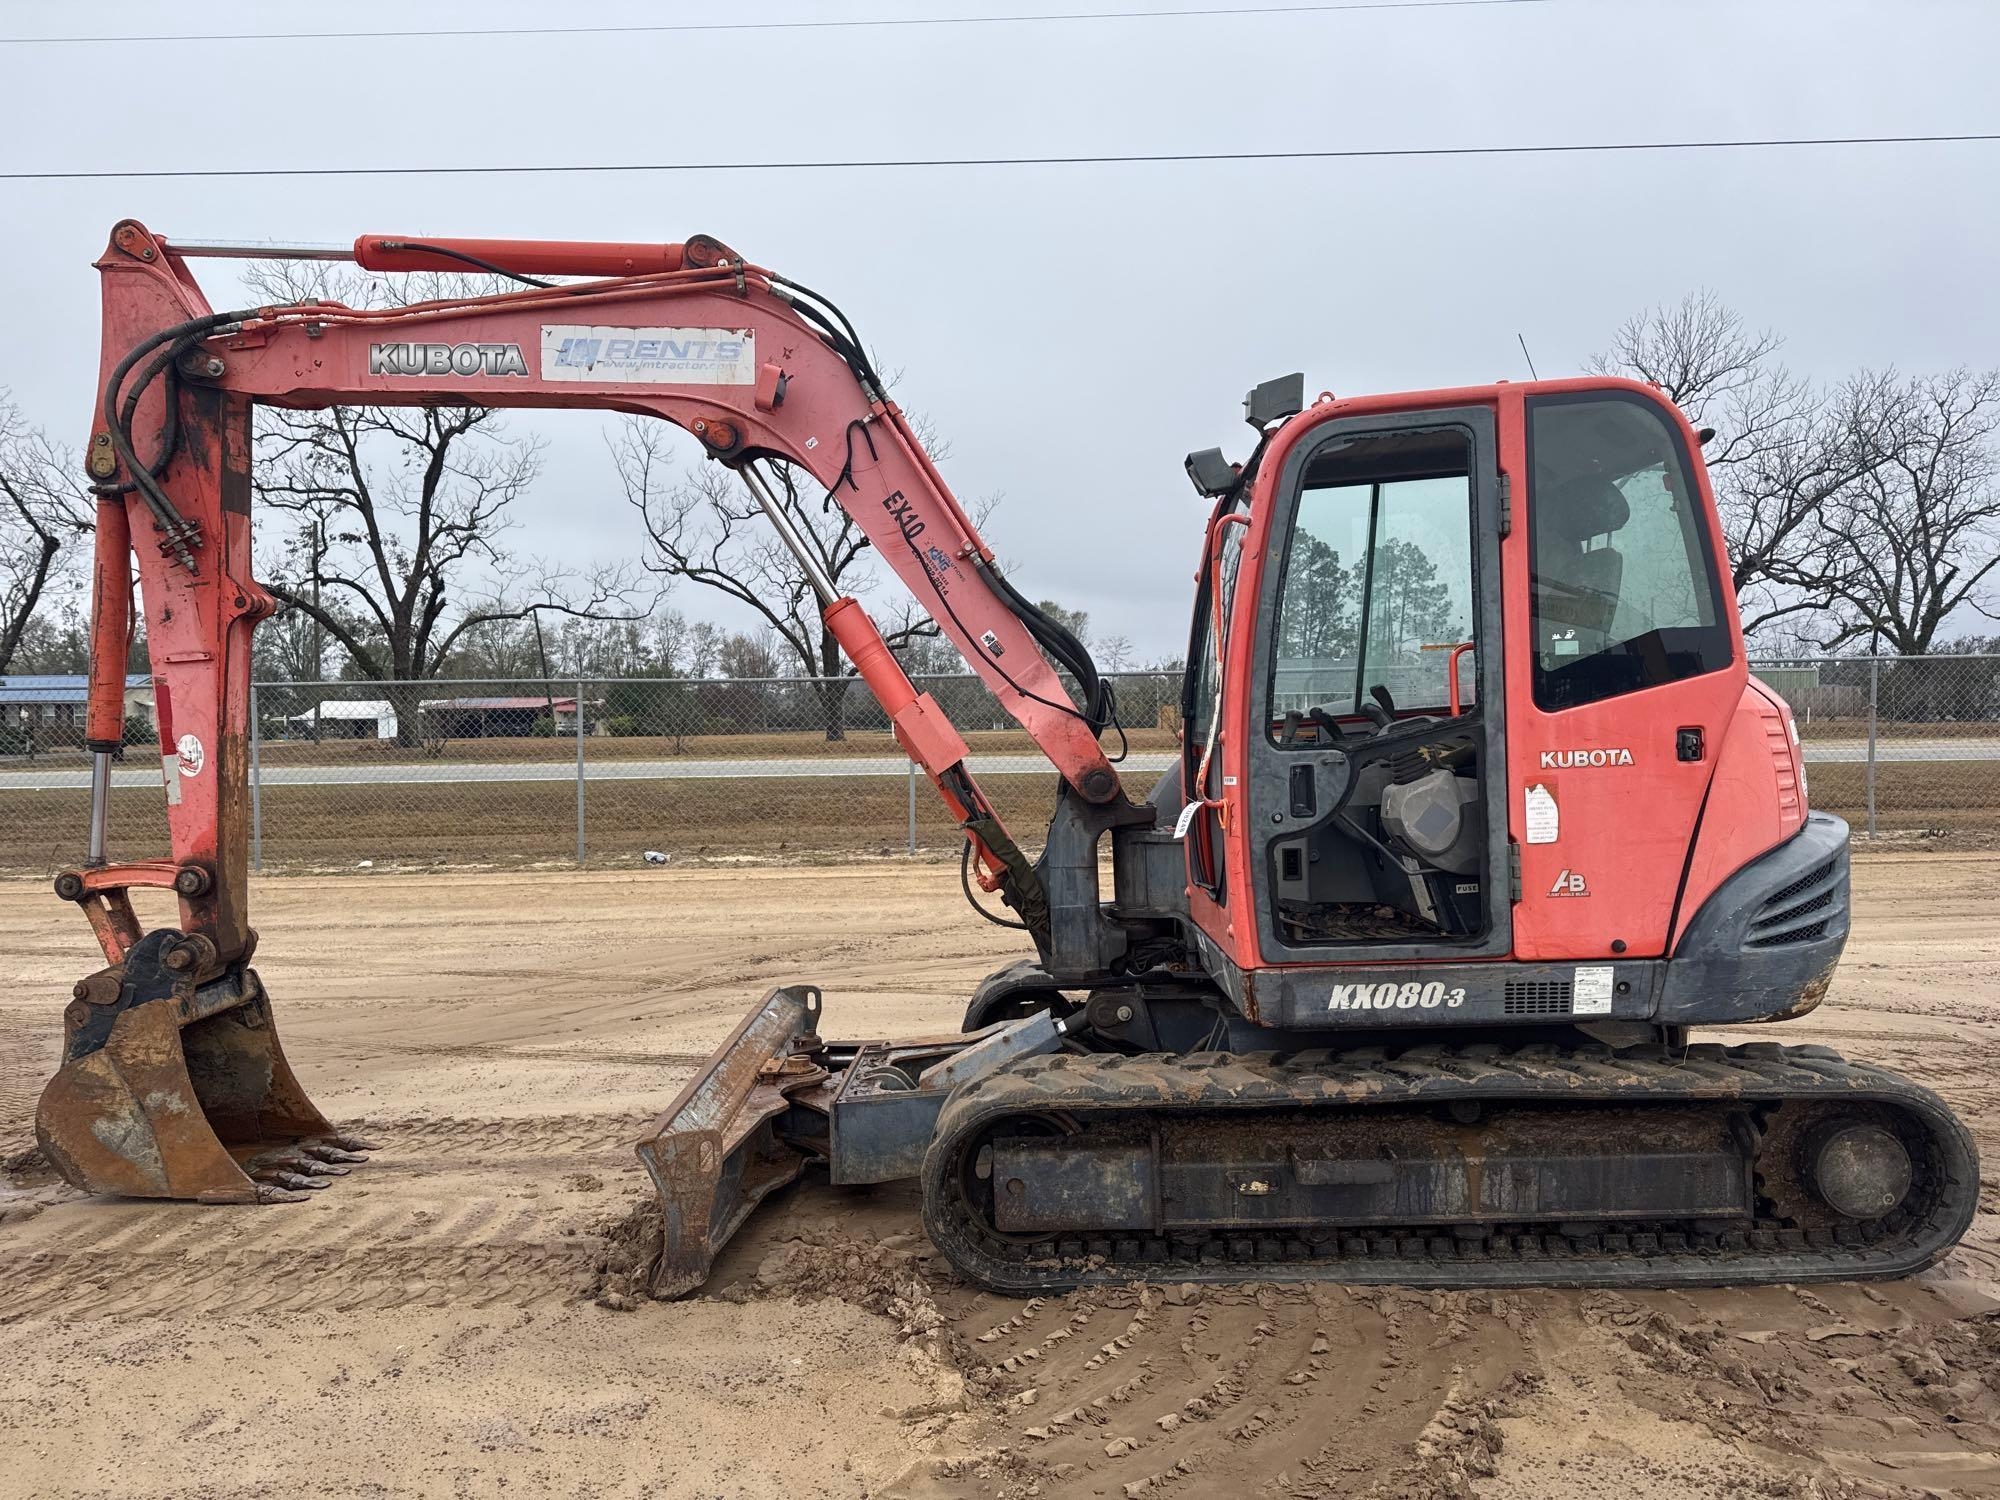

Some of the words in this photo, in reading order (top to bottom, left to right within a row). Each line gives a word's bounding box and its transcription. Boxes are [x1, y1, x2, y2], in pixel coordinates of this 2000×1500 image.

[368, 343, 528, 377] KUBOTA
[604, 339, 742, 360] RENTS
[882, 490, 925, 539] EX10
[1540, 748, 1635, 769] KUBOTA
[1551, 868, 1587, 893] AB
[1328, 981, 1465, 1010] KX080-3
